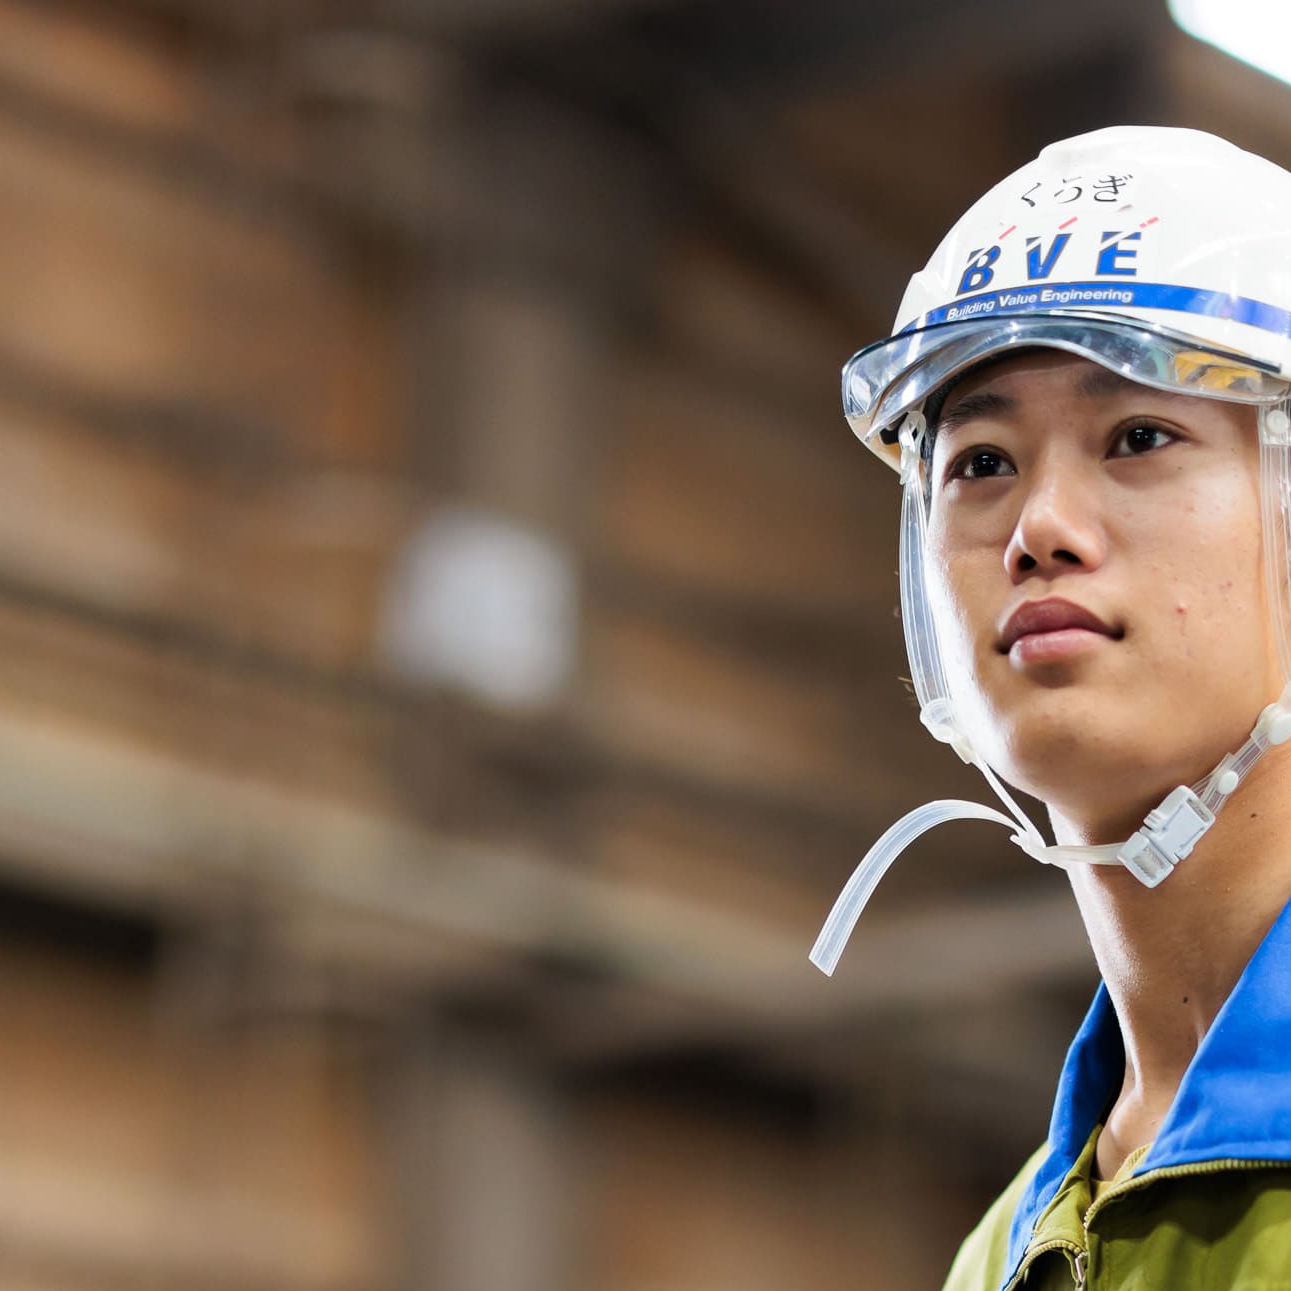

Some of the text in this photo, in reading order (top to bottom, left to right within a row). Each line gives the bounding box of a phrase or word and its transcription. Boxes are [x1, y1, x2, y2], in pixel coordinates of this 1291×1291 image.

[955, 230, 1143, 297] BVE
[946, 288, 1134, 321] Building Value Engineering
